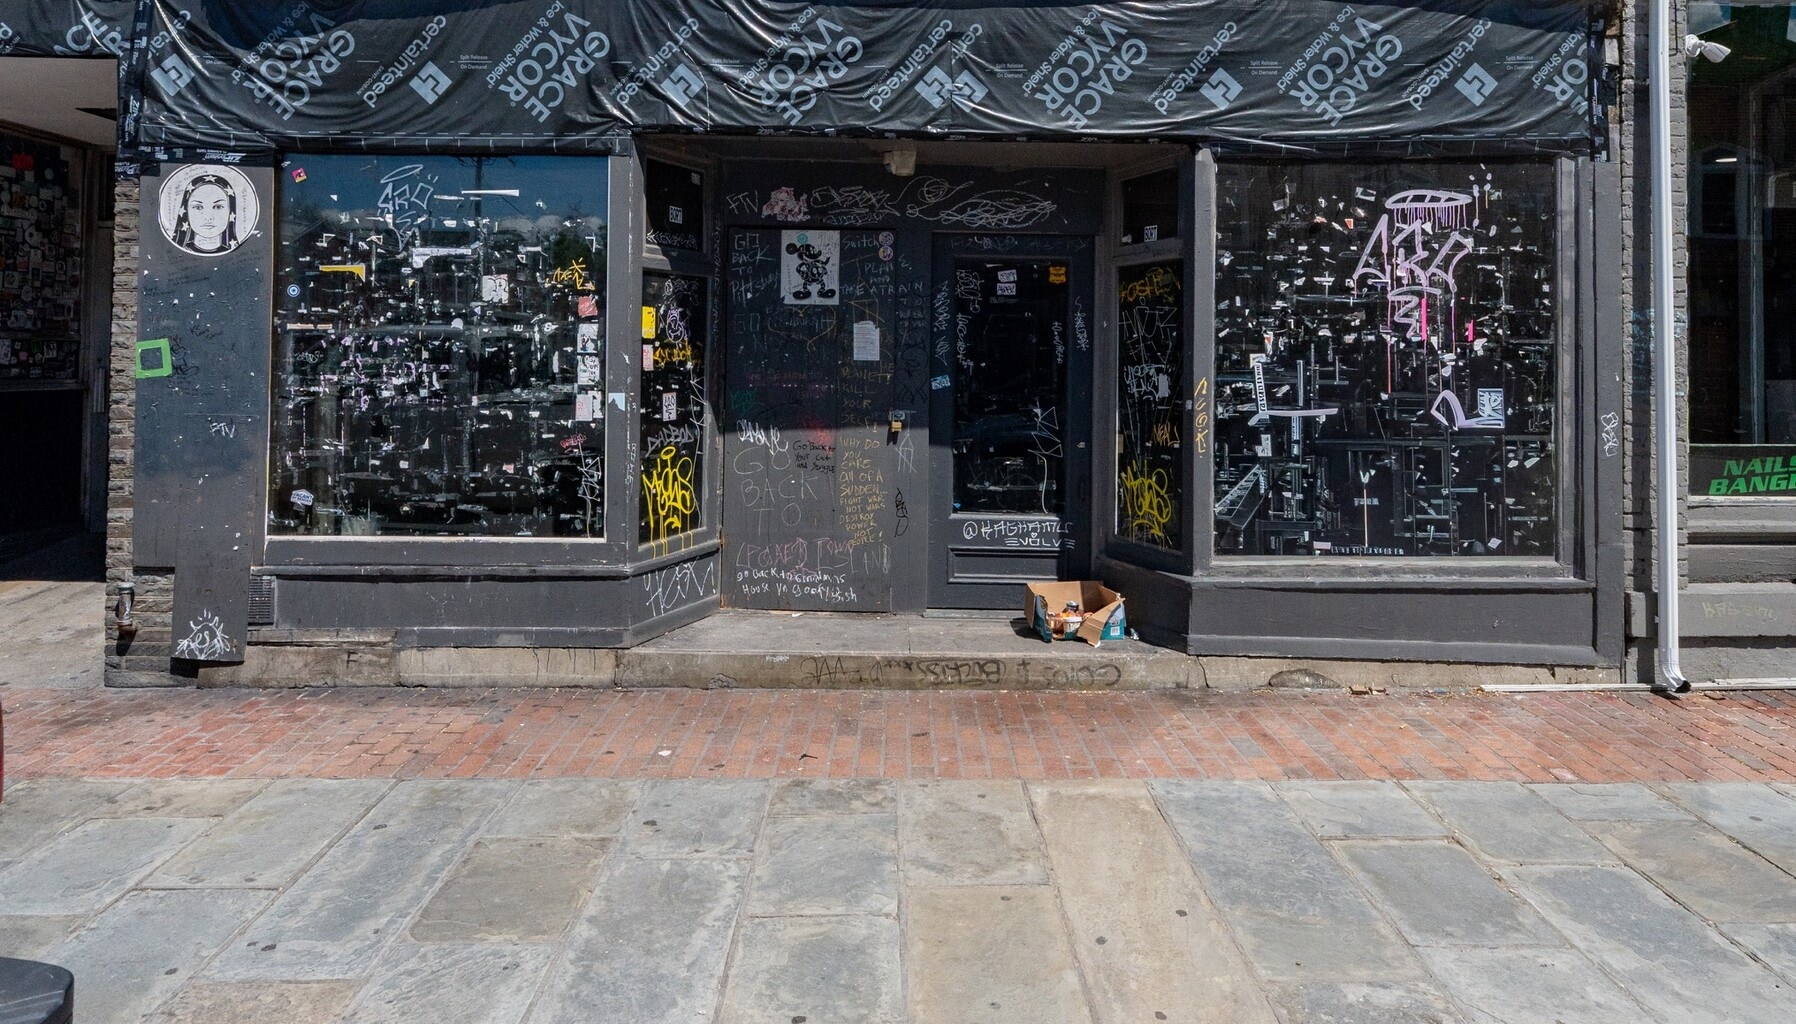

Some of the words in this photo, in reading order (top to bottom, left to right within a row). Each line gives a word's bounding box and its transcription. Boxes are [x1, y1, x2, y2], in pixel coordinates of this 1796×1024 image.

[536, 16, 549, 28] &
[548, 0, 564, 19] Ice
[1336, 6, 1354, 24] Ice
[510, 26, 542, 56] Water
[1328, 21, 1340, 32] &
[243, 12, 336, 104] VYCOR
[499, 12, 590, 102] VYCOR
[1302, 30, 1334, 60] Water
[273, 30, 354, 120] GRACE
[362, 15, 447, 108] certainteed
[486, 52, 516, 82] Shield
[523, 30, 610, 122] GRACE
[616, 18, 700, 107] certainteed
[750, 16, 844, 109] VYCOR
[869, 19, 952, 112] certainteed
[1034, 20, 1128, 111] VYCOR
[1154, 21, 1238, 114] certainteed
[1277, 59, 1308, 90] Shield
[1290, 16, 1382, 108] VYCOR
[1409, 16, 1492, 111] certainteed
[776, 37, 863, 126] GRACE
[1060, 38, 1148, 130] GRACE
[1315, 36, 1403, 126] GRACE
[726, 190, 758, 214] FTV
[732, 245, 776, 265] BACK
[732, 266, 752, 276] TO
[840, 436, 861, 448] WHY
[865, 438, 880, 450] DO
[843, 451, 860, 460] YOU
[734, 446, 790, 475] GO
[841, 459, 872, 470] CARE
[741, 471, 818, 506] BACK
[876, 470, 884, 483] A
[846, 505, 862, 513] NOT
[868, 495, 884, 503] WAR
[753, 502, 801, 536] TO
[854, 528, 872, 539] NOT
